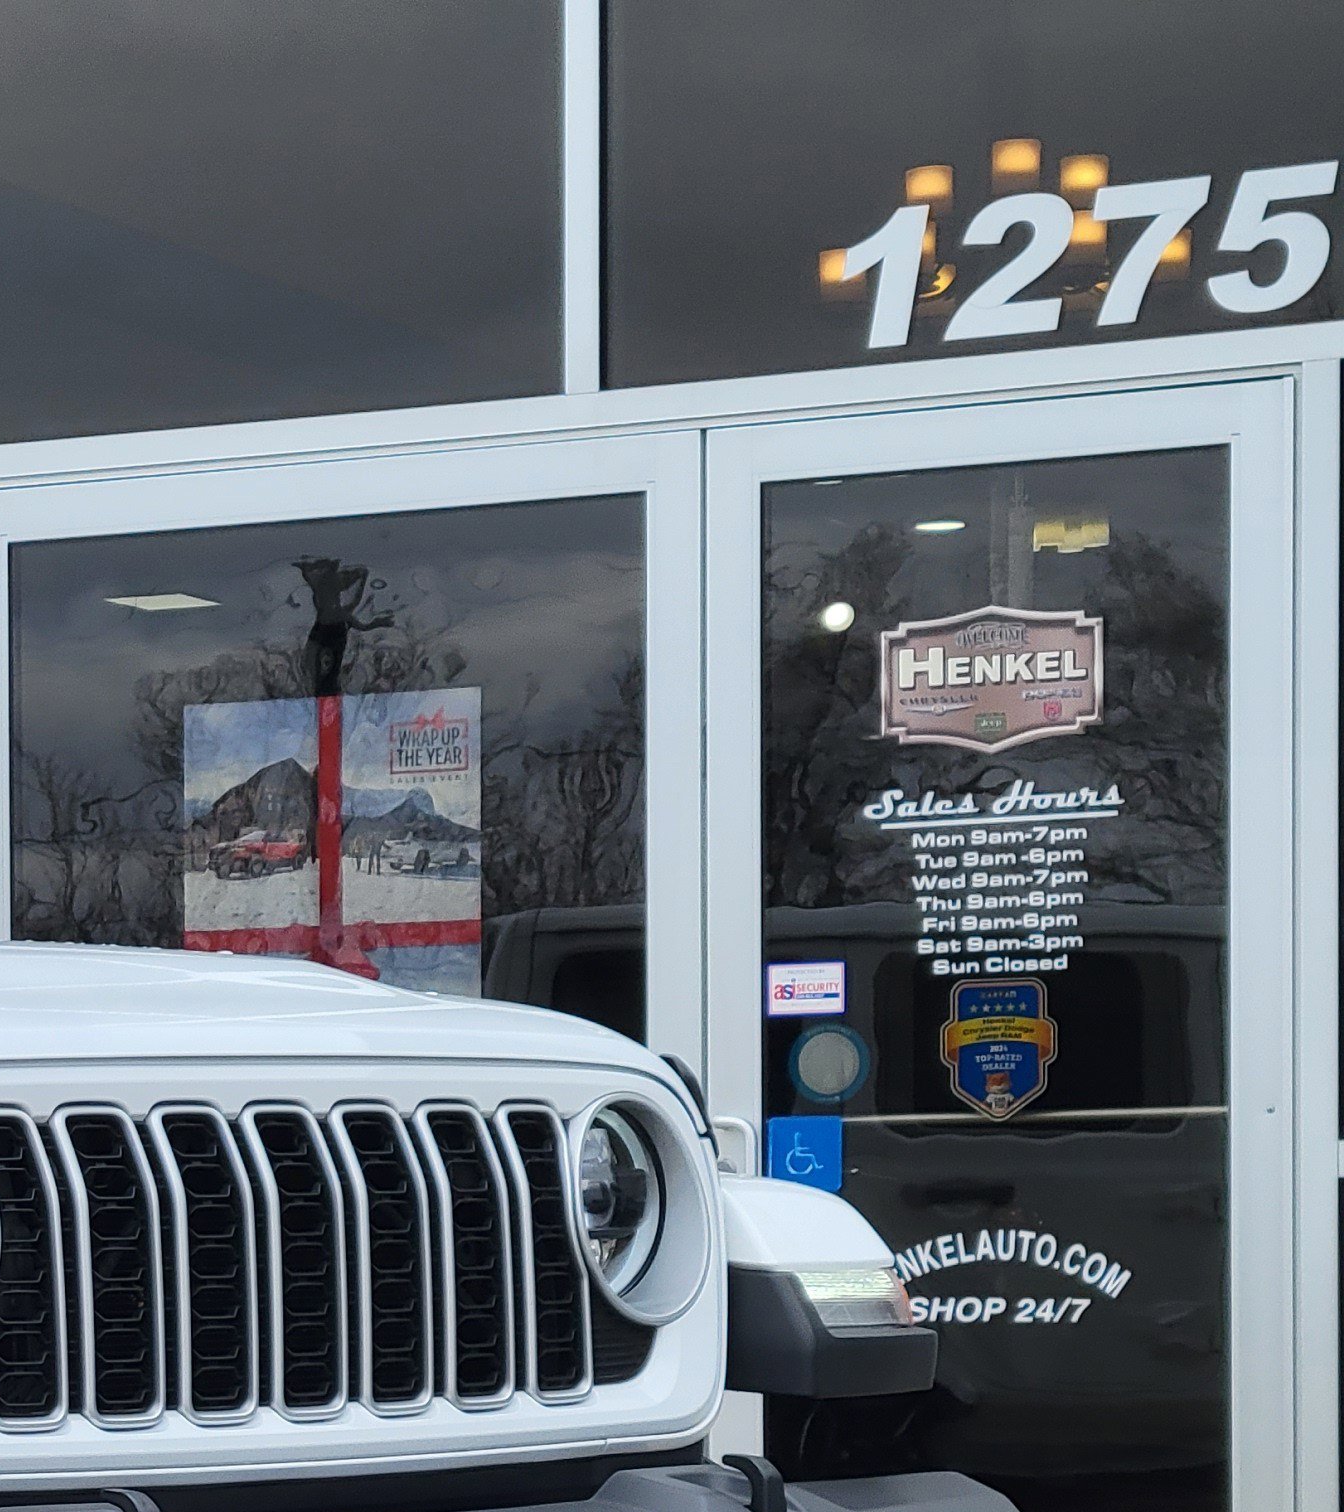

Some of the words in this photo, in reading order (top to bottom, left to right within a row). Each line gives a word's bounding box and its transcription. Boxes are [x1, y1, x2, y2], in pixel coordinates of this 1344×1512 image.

[842, 160, 1339, 349] 1275
[898, 646, 1089, 689] HENKEL
[398, 727, 439, 748] WRAP
[441, 726, 460, 746] UP
[397, 748, 423, 767] THE
[426, 746, 462, 766] YEAR
[863, 789, 980, 820] Sales
[992, 779, 1126, 815] Hours
[912, 832, 965, 849] Mon
[970, 825, 1088, 845] 9am-7pm
[915, 853, 957, 870] Tue
[963, 851, 1016, 868] 9am
[912, 873, 966, 891] Wed
[970, 868, 1089, 888] 9am-7pm
[916, 896, 962, 912] Thu
[966, 890, 1084, 910] 9am-6pm
[922, 916, 956, 933] Fri
[961, 912, 1079, 931] 9am-6pm
[916, 938, 962, 955] Sat
[966, 933, 1084, 953] 9am-3pm
[932, 958, 980, 975] Sun
[985, 953, 1069, 973] Closed
[796, 982, 840, 993] SECURITY
[895, 1228, 1132, 1299] NKELAUTO.COM
[910, 1296, 1007, 1324] SHOP
[1014, 1296, 1092, 1324] 24/7
